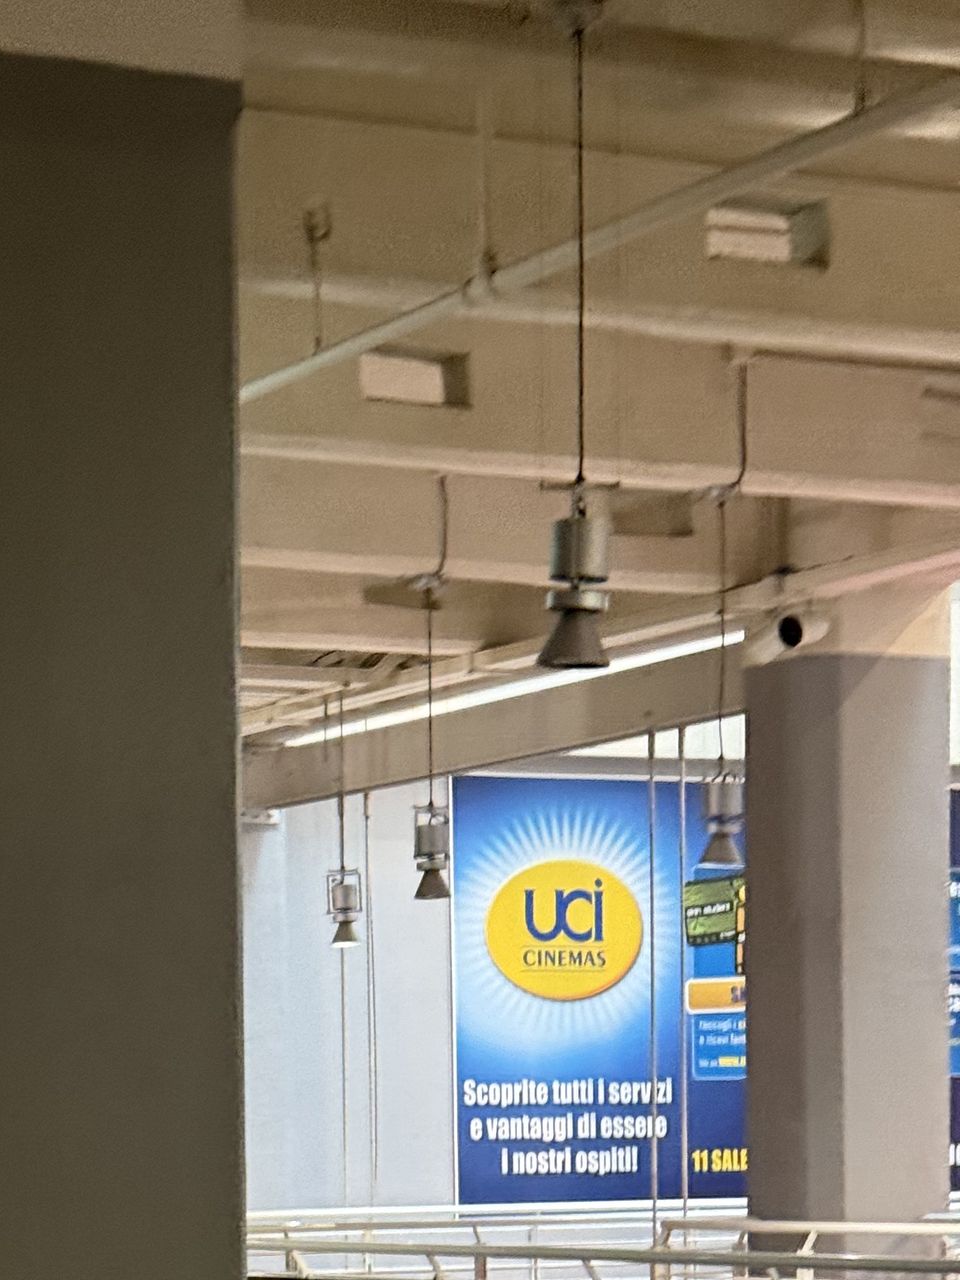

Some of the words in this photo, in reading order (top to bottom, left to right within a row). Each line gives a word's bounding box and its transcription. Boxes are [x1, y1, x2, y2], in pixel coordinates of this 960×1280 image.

[524, 878, 603, 942] uci
[522, 949, 606, 968] CINEMAS
[463, 1078, 548, 1108] Scoprite
[552, 1078, 594, 1105] tutti
[470, 1117, 483, 1141] e
[486, 1112, 574, 1142] vantaggi
[577, 1112, 596, 1139] di
[600, 1115, 668, 1139] essere
[512, 1147, 572, 1175] nostri
[575, 1146, 639, 1175] ospiti!
[692, 1149, 708, 1172] 11
[711, 1148, 748, 1172] SALE
